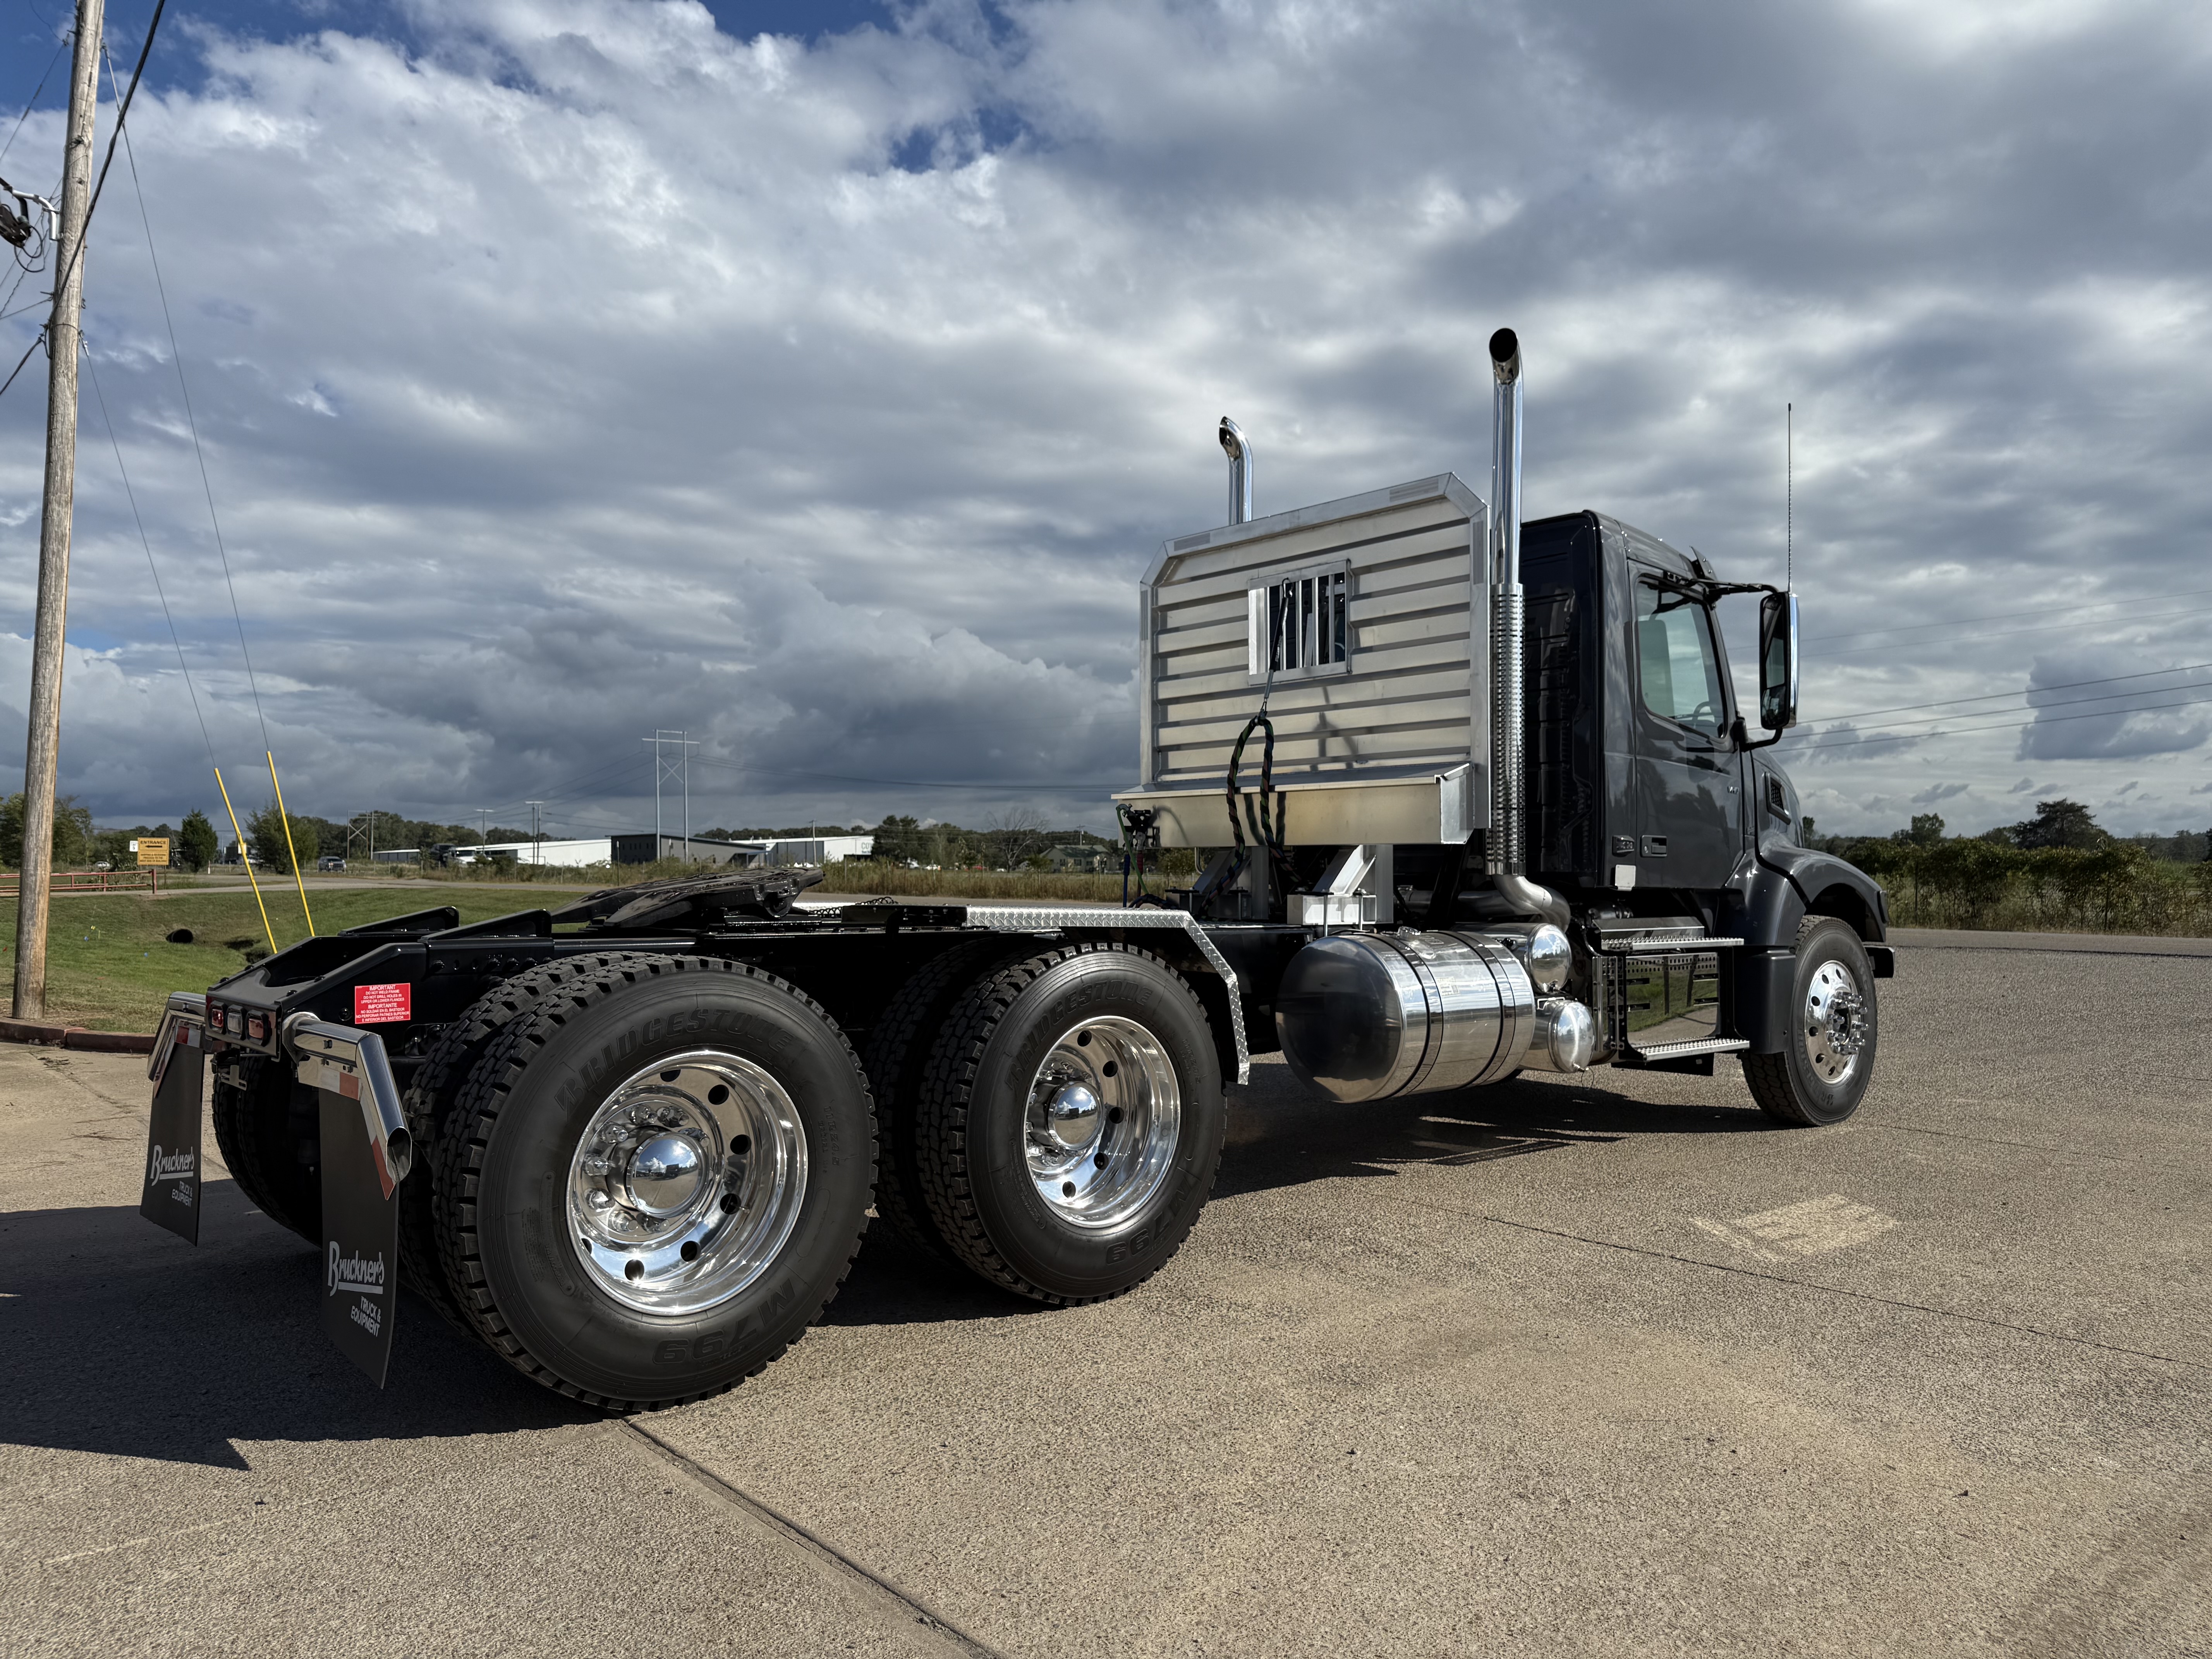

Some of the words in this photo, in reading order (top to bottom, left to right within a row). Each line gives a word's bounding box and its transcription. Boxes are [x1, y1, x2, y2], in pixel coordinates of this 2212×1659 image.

[1005, 980, 1152, 1091] BRIDGESTONE
[554, 1008, 794, 1116] BRIDGESTONE
[150, 1145, 194, 1186] Bruckner's
[172, 1188, 192, 1207] EQUIPMENT
[179, 1180, 190, 1196] TRUCK
[190, 1187, 192, 1197] &
[328, 1241, 385, 1297] Bruckner's
[351, 1305, 380, 1337] EQUIPMENT
[361, 1296, 377, 1320] TRUCK
[377, 1309, 381, 1323] &
[653, 1278, 795, 1364] M799
